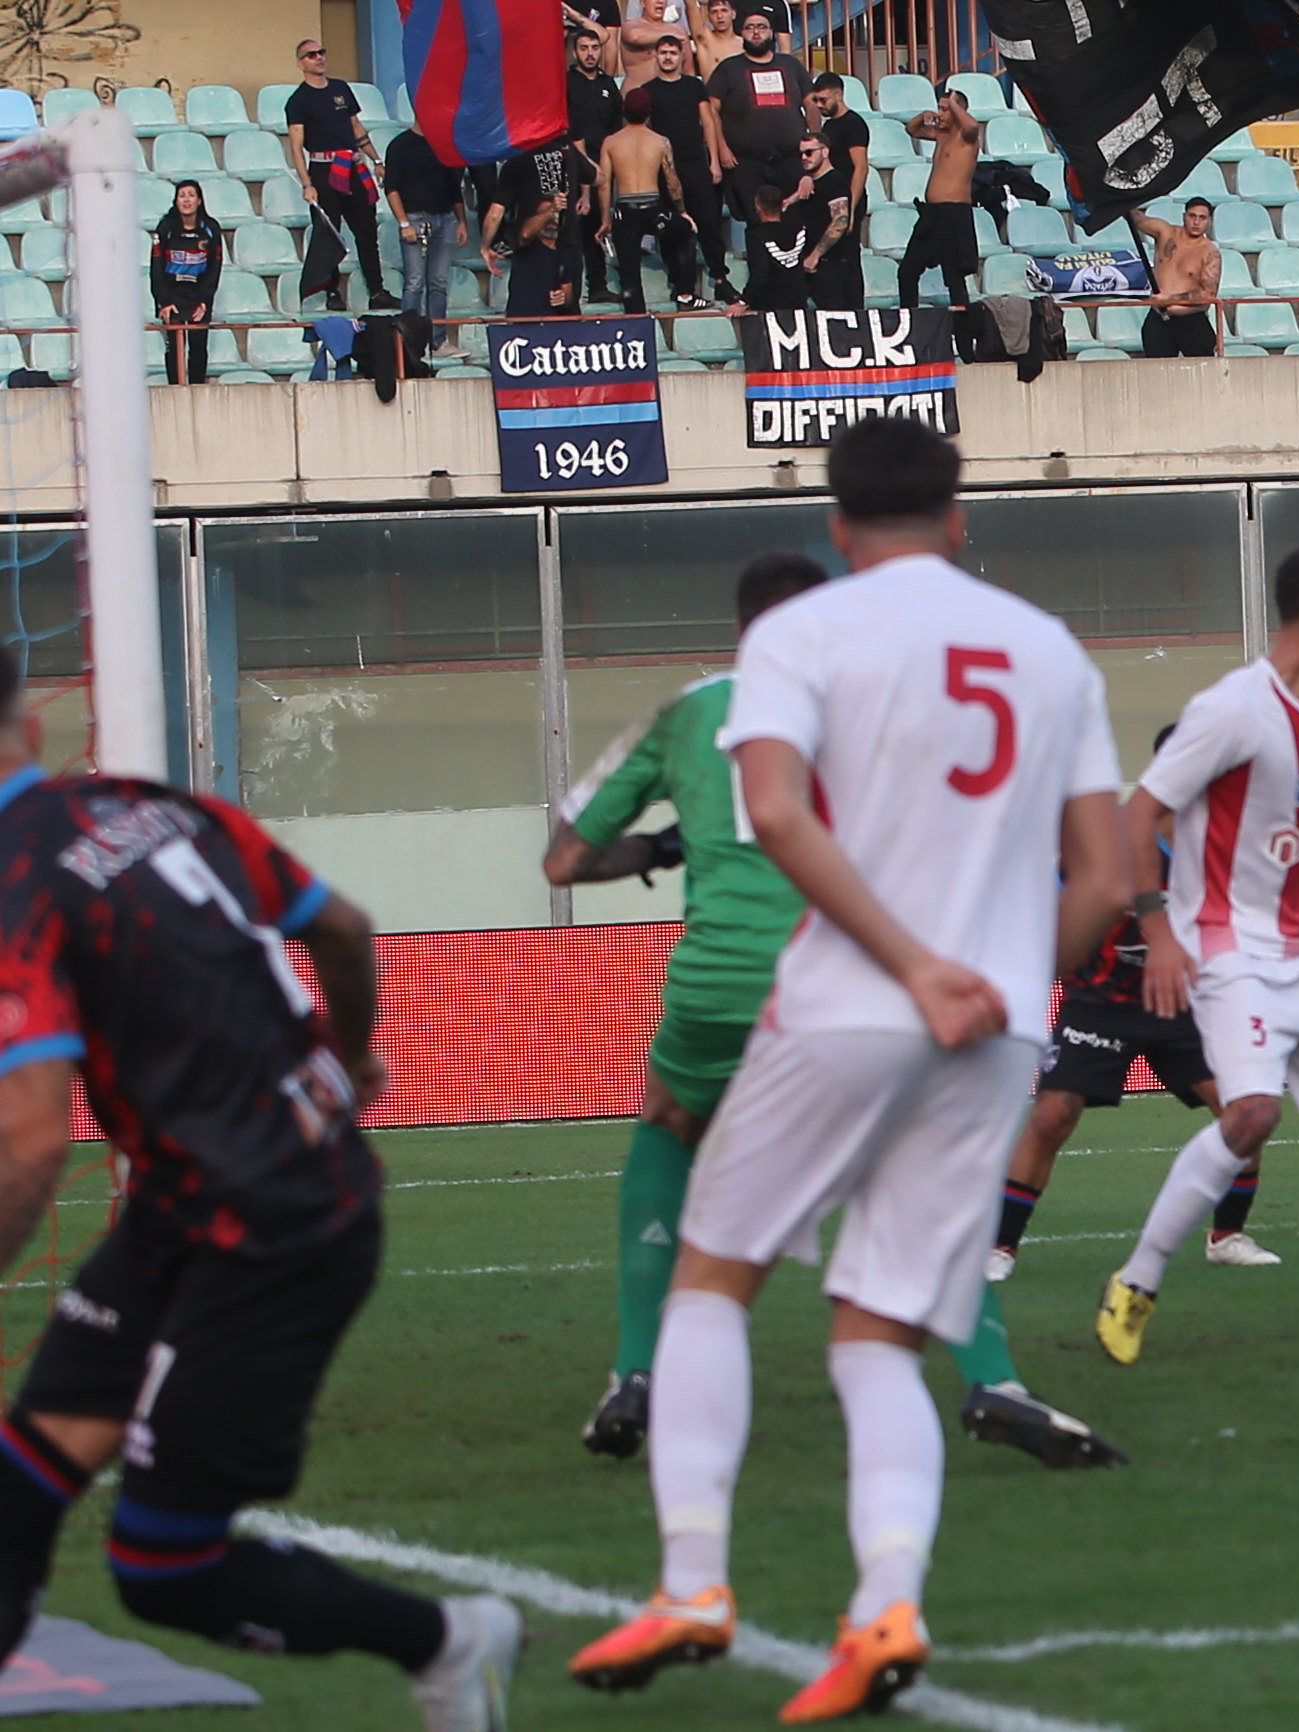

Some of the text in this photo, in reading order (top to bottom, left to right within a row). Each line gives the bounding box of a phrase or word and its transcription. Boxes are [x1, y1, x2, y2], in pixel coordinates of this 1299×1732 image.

[500, 331, 646, 376] Catania
[535, 439, 629, 479] 1946
[946, 645, 1016, 797] 5
[1250, 1016, 1267, 1046] 3
